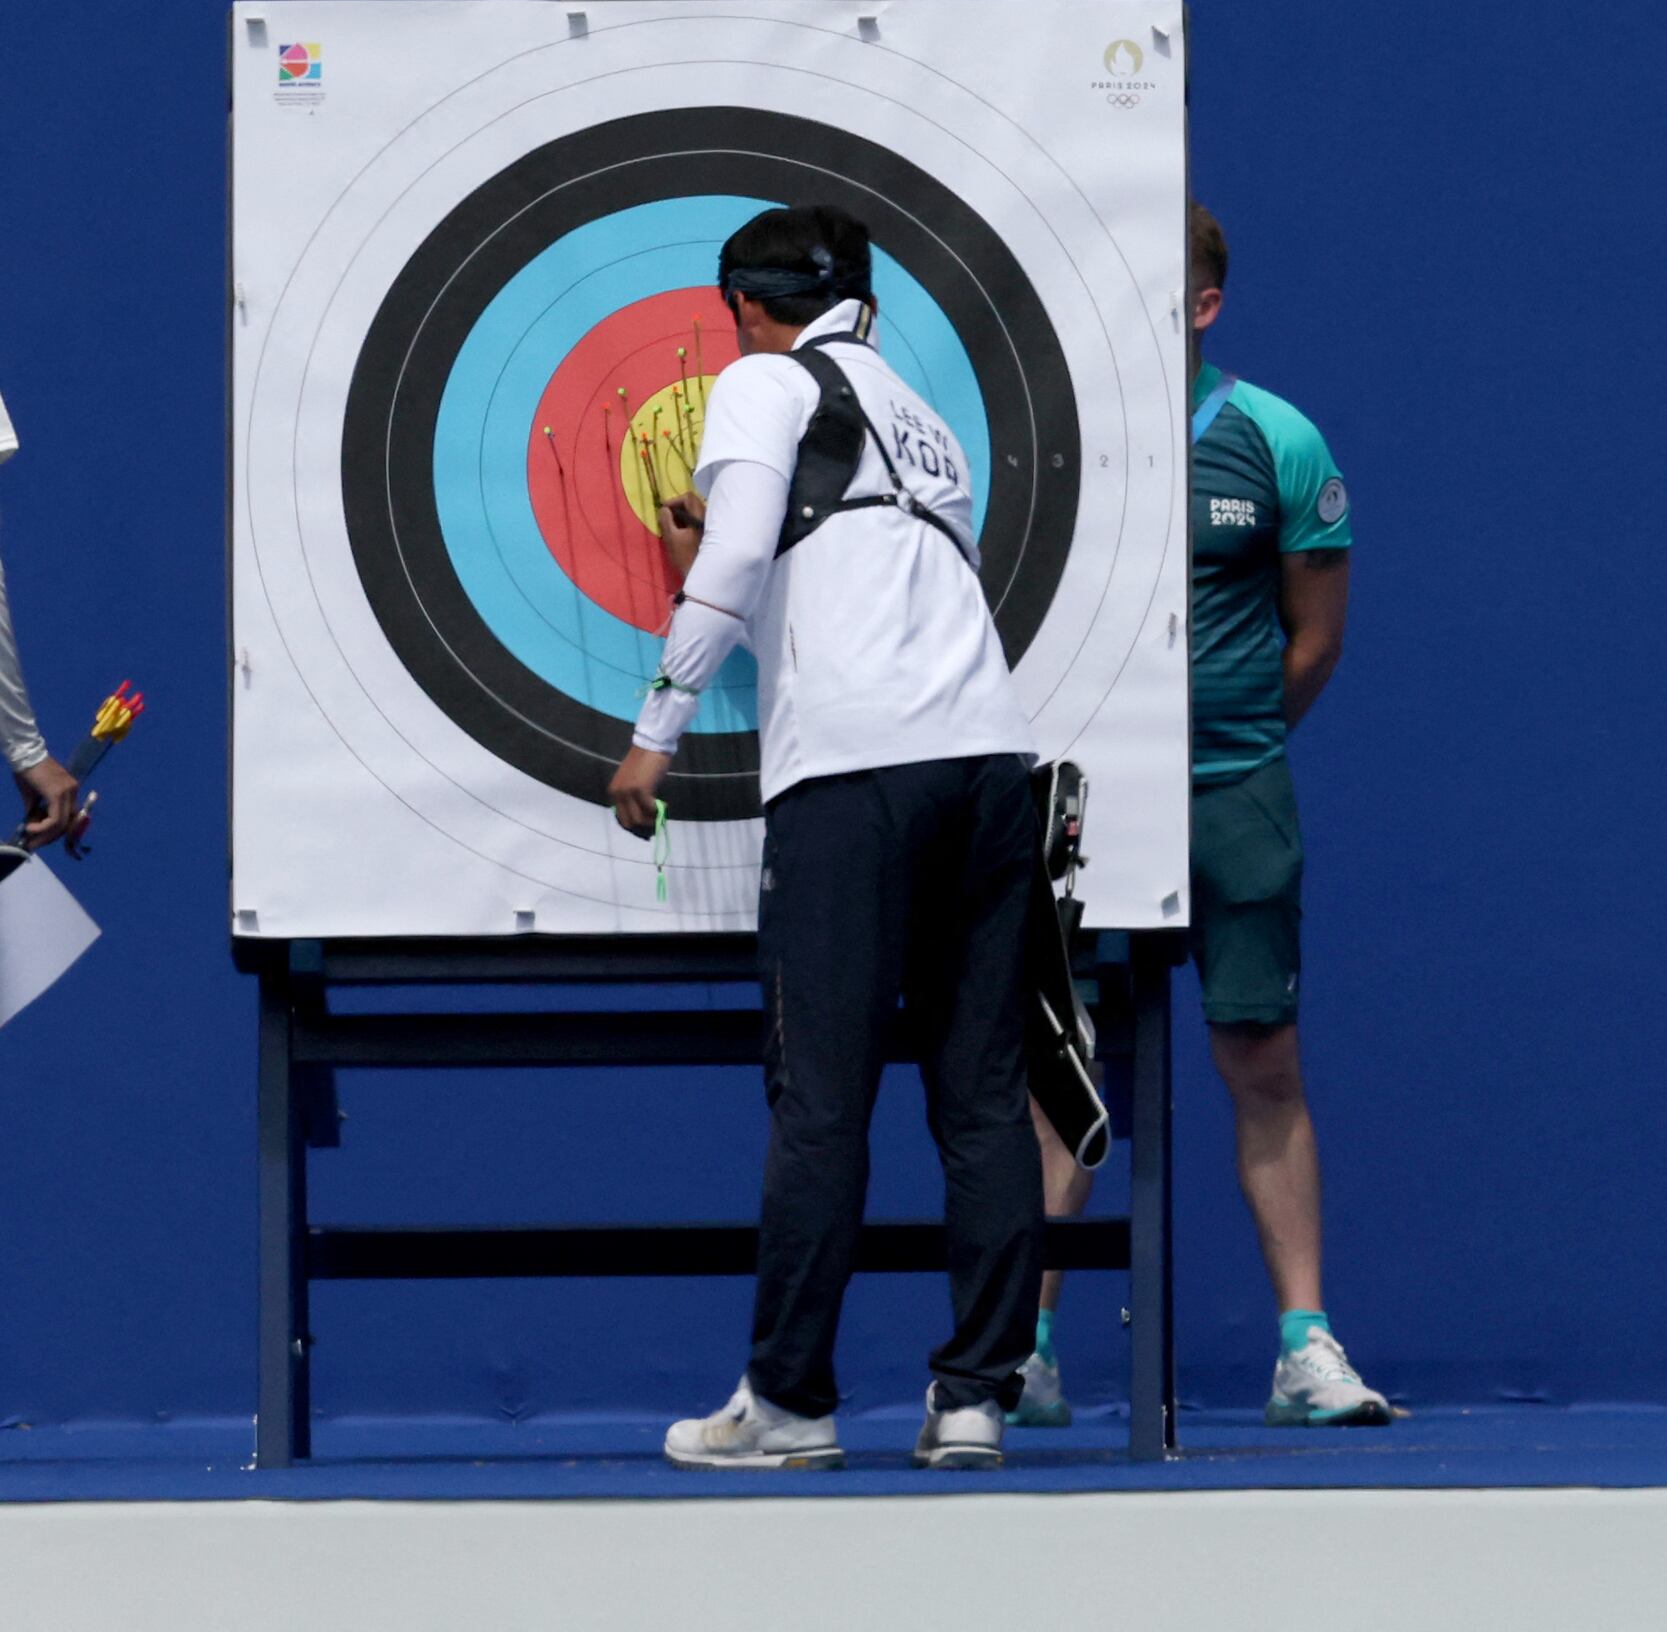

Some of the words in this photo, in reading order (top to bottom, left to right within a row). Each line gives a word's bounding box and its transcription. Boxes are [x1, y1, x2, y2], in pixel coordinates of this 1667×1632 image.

[1091, 81, 1123, 89] PARIS
[1126, 81, 1157, 89] 2024
[1052, 453, 1065, 469] 3
[1099, 454, 1110, 468] 2
[1210, 498, 1256, 513] PARIS
[1210, 511, 1257, 527] 2024
